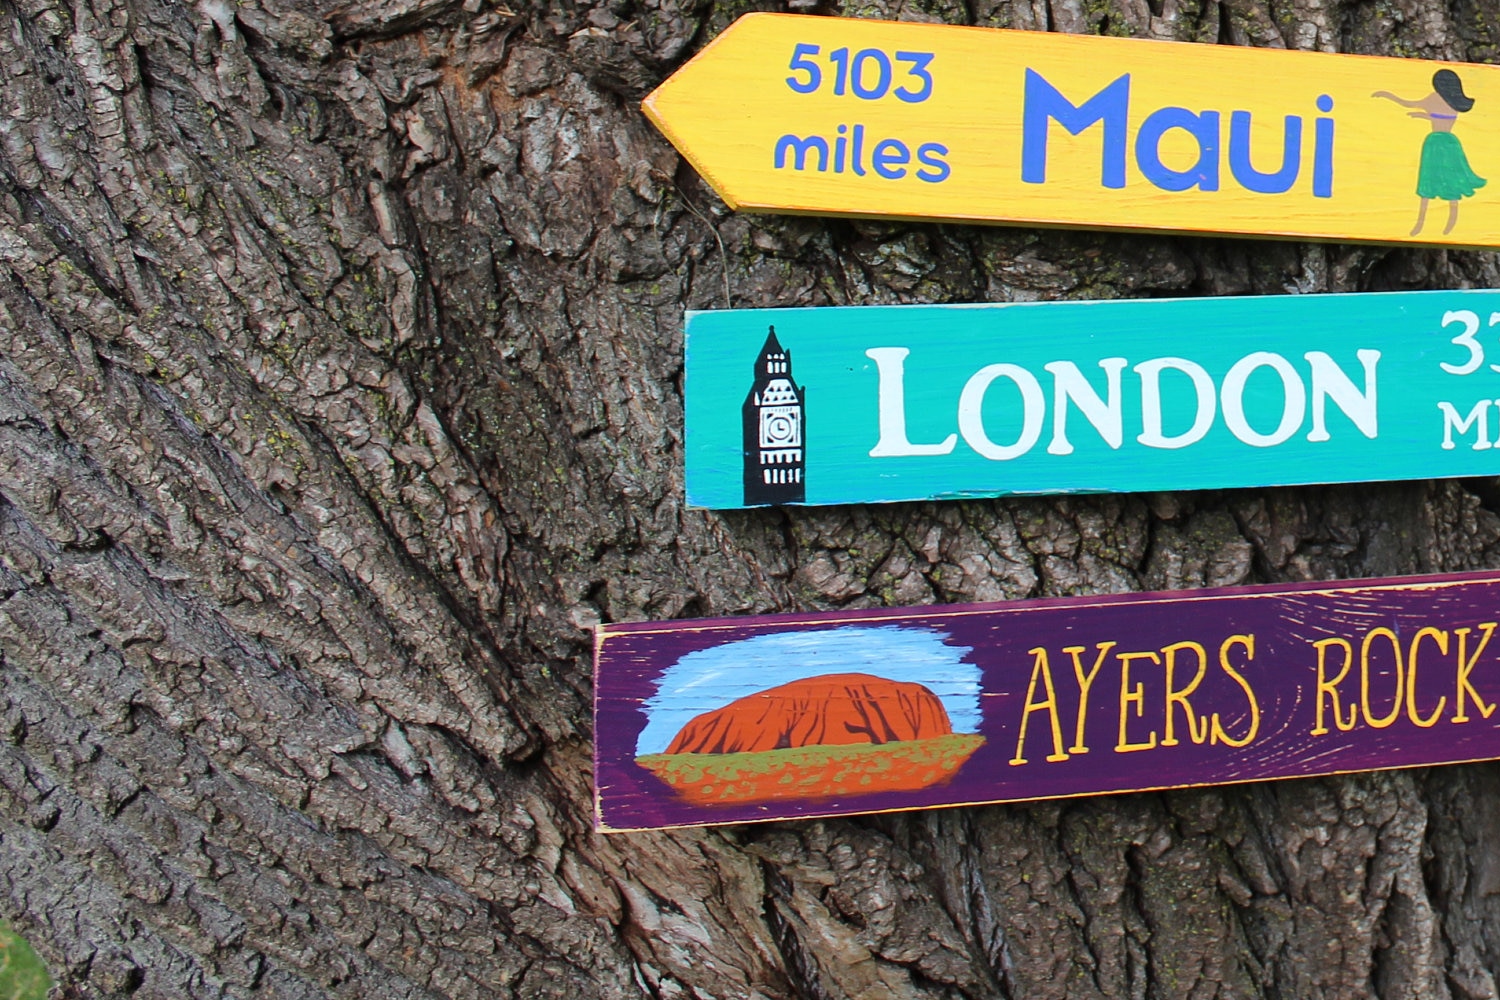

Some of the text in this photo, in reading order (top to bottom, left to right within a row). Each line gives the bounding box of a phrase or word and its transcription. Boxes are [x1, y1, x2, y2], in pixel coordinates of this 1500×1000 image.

[785, 43, 934, 104] 5103
[774, 126, 951, 184] miles
[1021, 66, 1333, 199] Maui
[869, 346, 1381, 460] LONDON
[1009, 622, 1497, 766] AYERS ROCK
